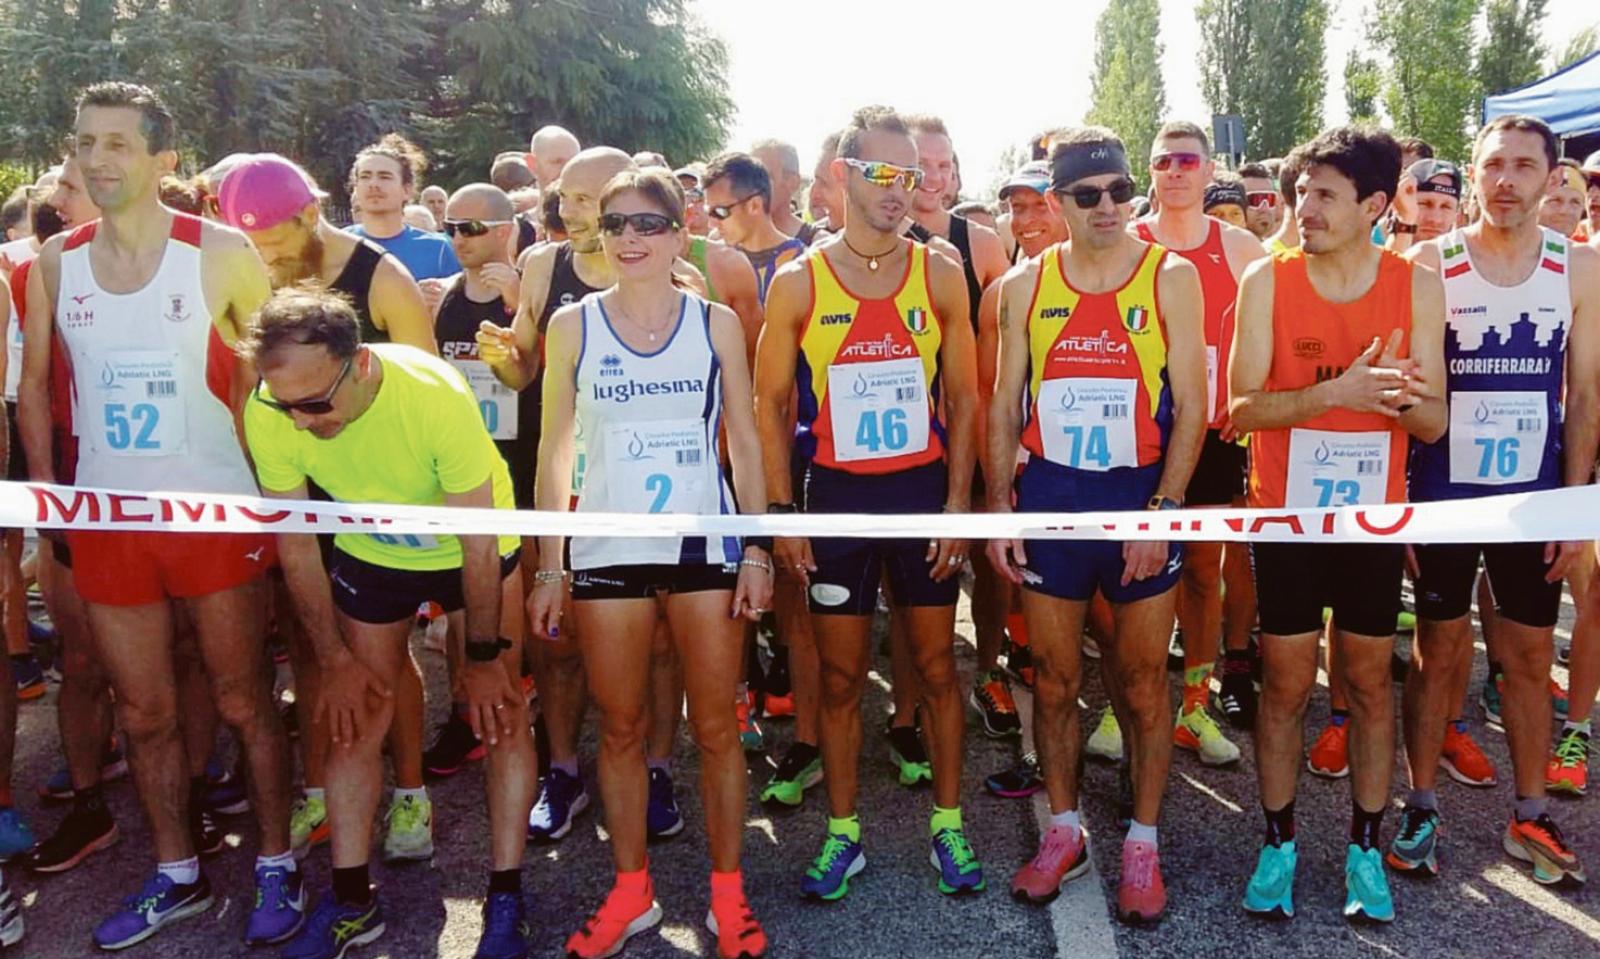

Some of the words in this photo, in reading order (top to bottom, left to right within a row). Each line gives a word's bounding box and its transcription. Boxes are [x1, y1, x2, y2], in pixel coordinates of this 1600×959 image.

[594, 379, 704, 402] lughesina
[104, 403, 160, 449] 52
[855, 408, 909, 452] 46
[1064, 425, 1112, 467] 74
[1474, 437, 1520, 478] 76
[645, 474, 673, 514] 2
[1312, 478, 1361, 507] 73
